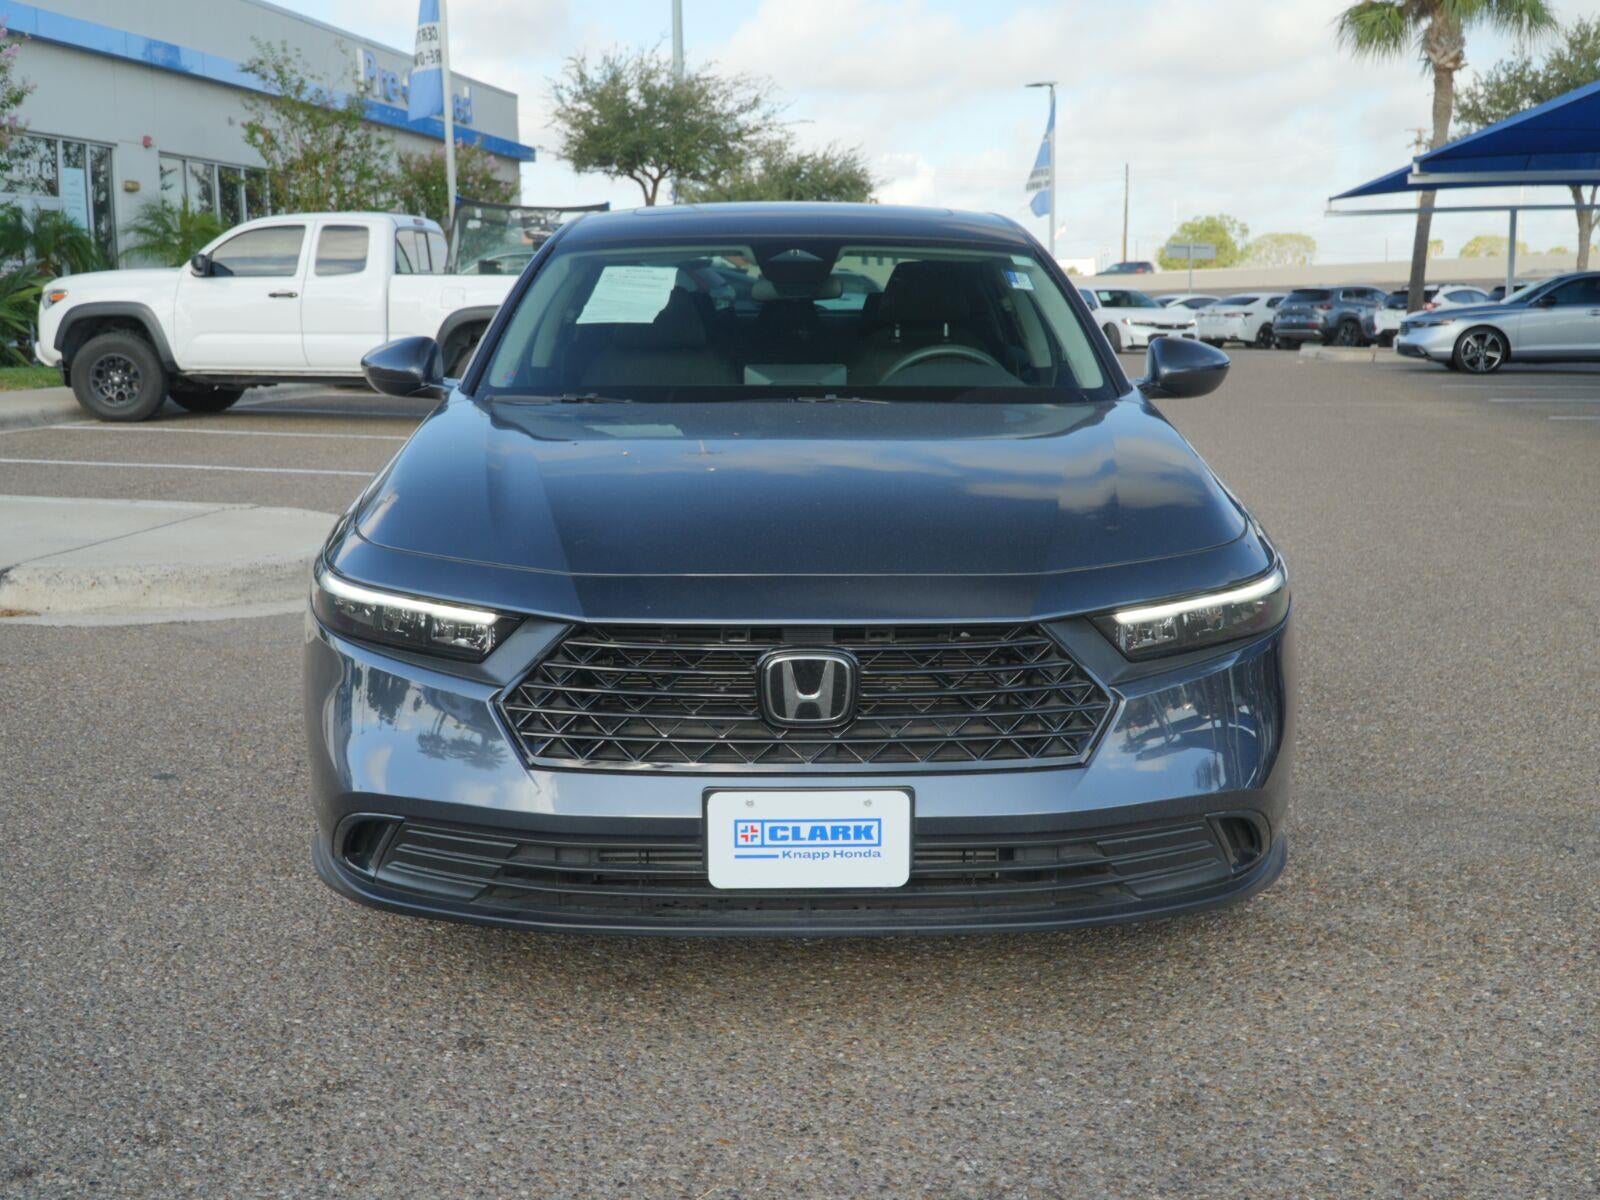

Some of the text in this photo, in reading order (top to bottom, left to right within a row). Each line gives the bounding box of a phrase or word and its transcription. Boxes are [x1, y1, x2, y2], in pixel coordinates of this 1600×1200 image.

[768, 824, 875, 842] CLARK
[782, 849, 882, 861] Knapp Honda
